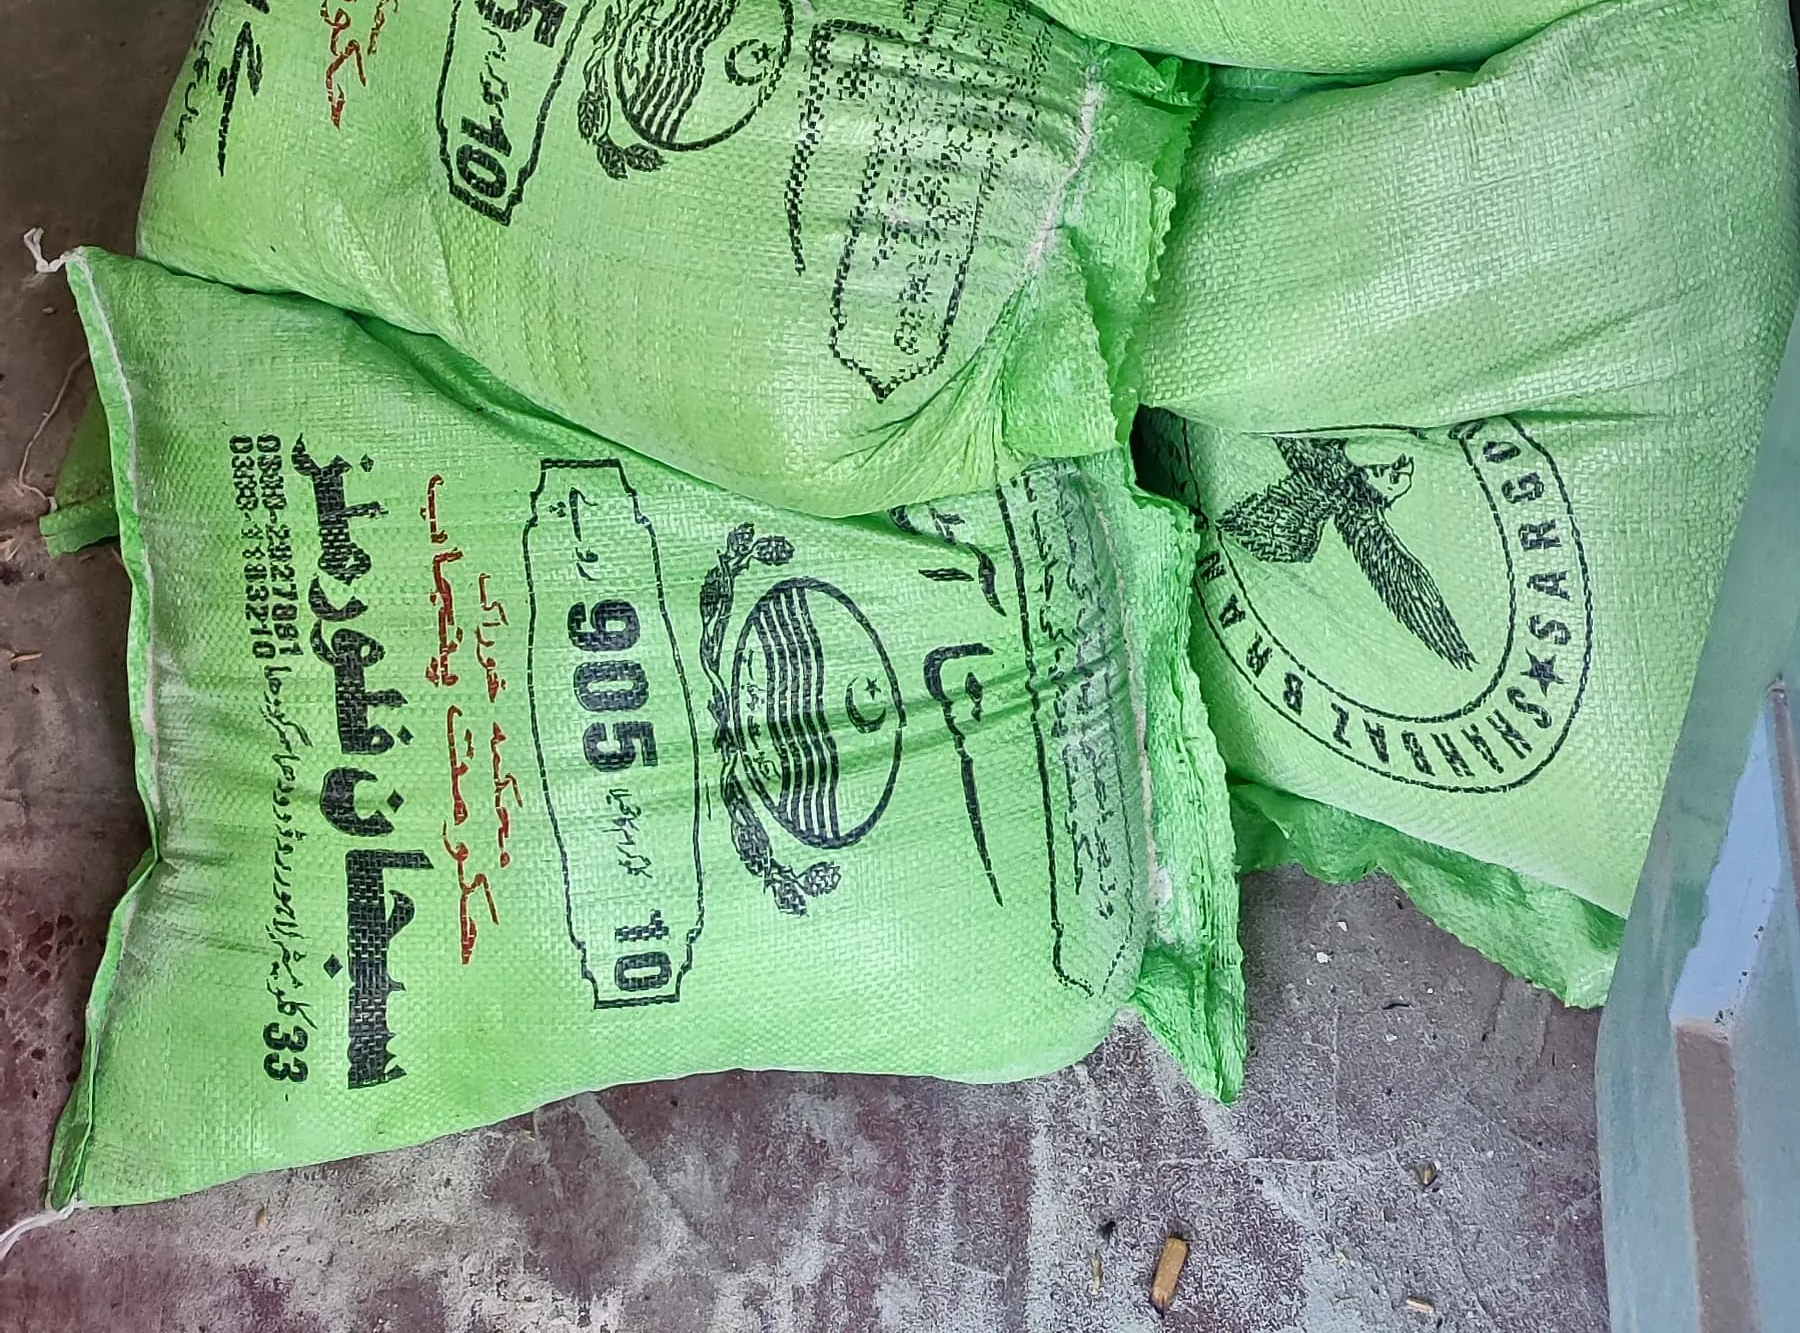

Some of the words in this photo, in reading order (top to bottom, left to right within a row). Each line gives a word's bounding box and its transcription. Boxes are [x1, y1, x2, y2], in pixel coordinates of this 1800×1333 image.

[456, 113, 515, 201] 10
[289, 431, 389, 586] ملز
[418, 473, 463, 688] پنجاب
[306, 584, 414, 756] فلور
[473, 571, 509, 704] خوراک
[1192, 509, 1305, 717] BRAN
[489, 720, 523, 868] محکمہ
[565, 598, 659, 773] 905
[613, 907, 672, 993] 10
[921, 641, 1005, 907] سستا
[1329, 685, 1554, 778] SHAHBAZ
[441, 704, 500, 965] حکومت
[318, 764, 435, 1090] سبحان
[262, 1021, 307, 1083] 33
